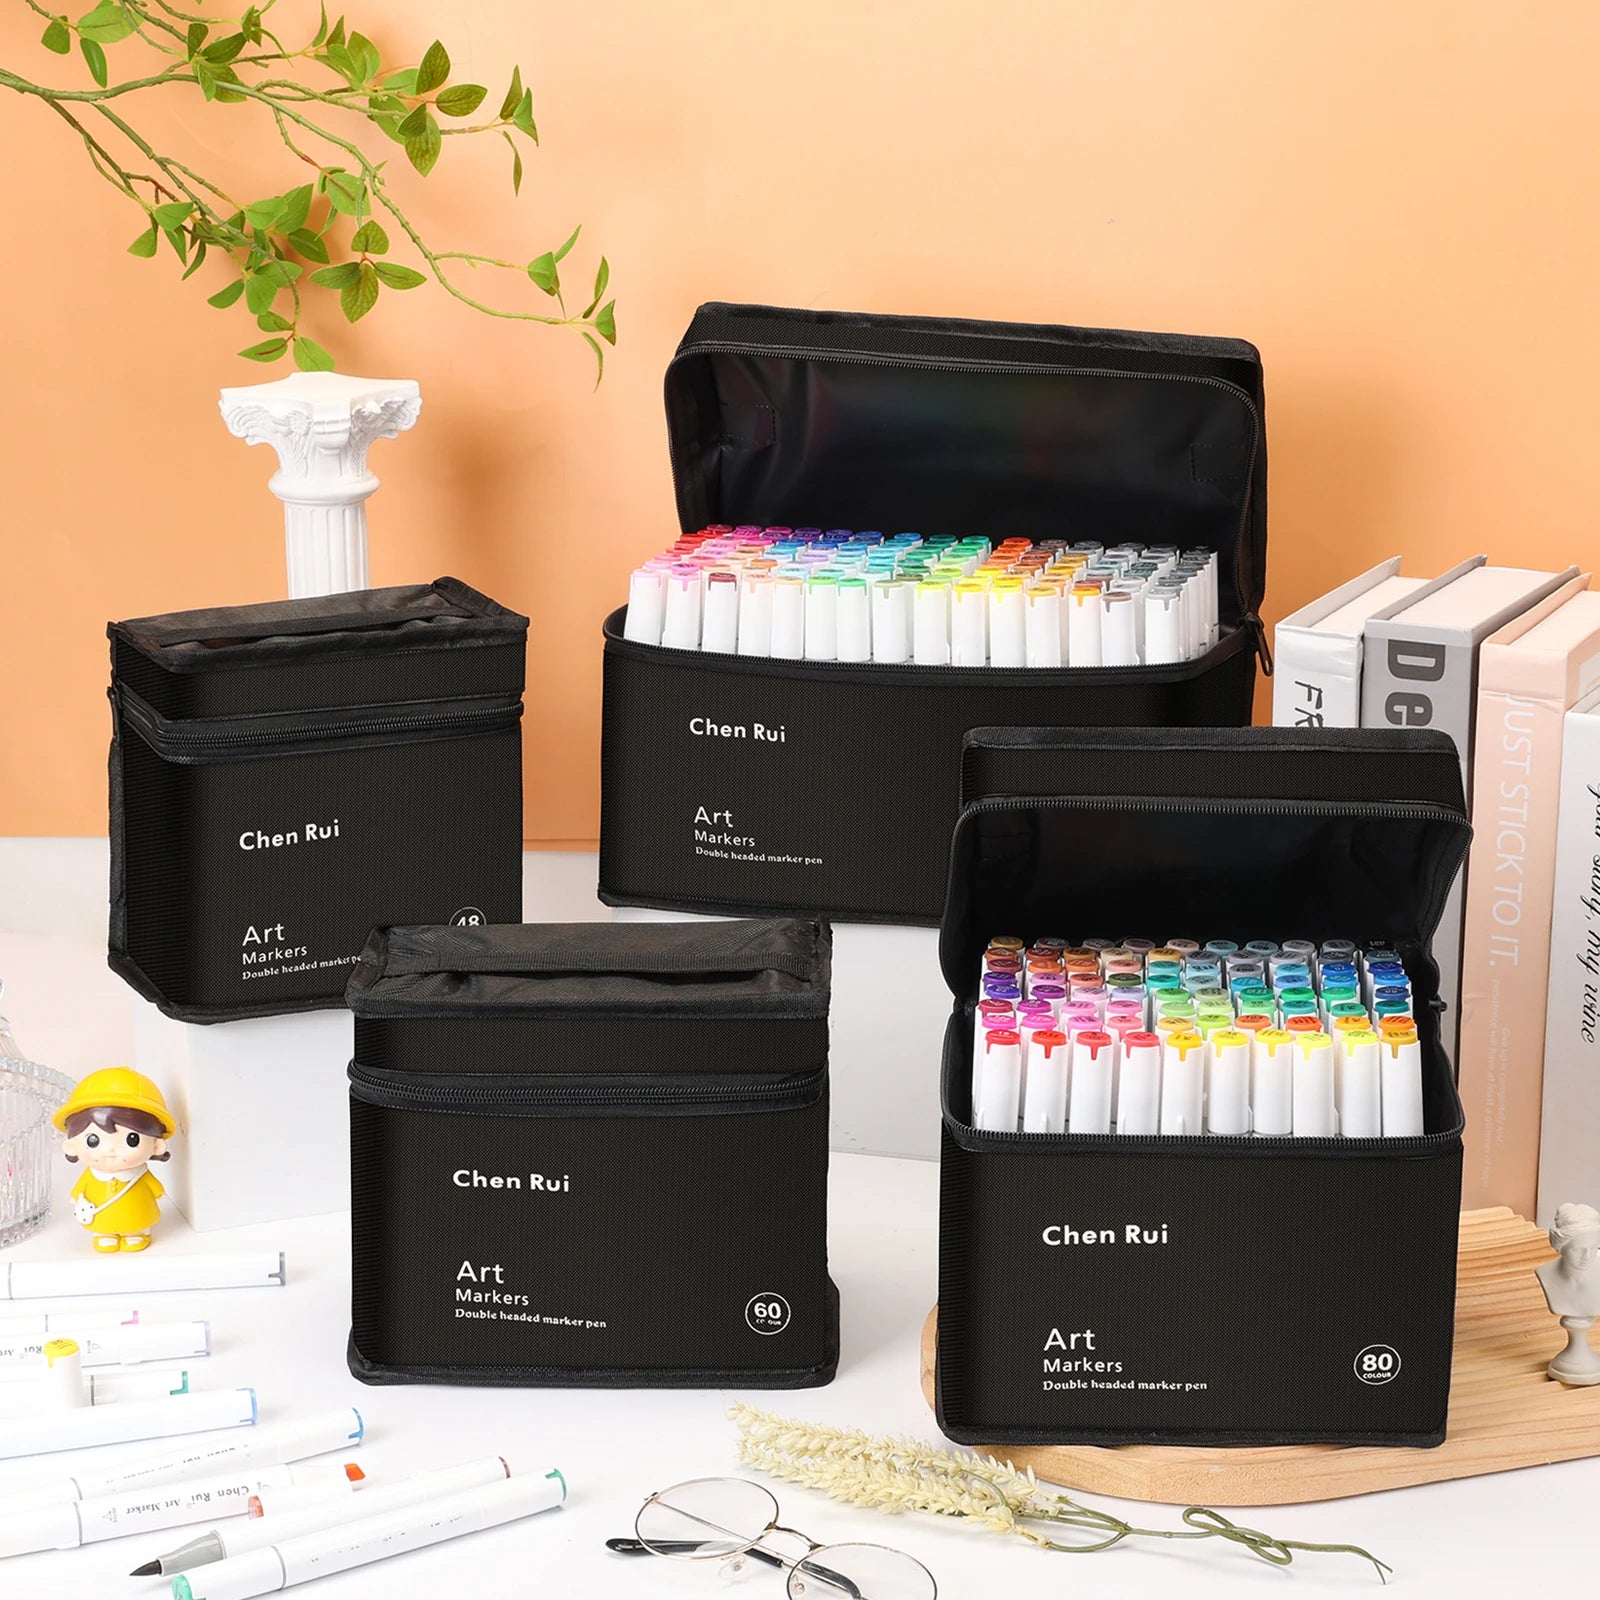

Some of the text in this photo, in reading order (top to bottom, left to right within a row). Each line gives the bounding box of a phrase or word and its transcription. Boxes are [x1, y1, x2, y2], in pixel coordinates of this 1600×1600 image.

[1385, 639, 1446, 726] De
[689, 718, 786, 742] Chen Rui
[693, 805, 734, 828] Art
[239, 818, 340, 851] Chen Rui
[694, 829, 756, 847] Markers
[1488, 697, 1535, 967] JUST STICK TO IT.
[695, 846, 823, 866] Double headed marker pen
[242, 922, 285, 947] Art
[242, 945, 308, 966] Markers
[242, 966, 280, 981] Double
[281, 959, 318, 975] headed
[1580, 983, 1600, 1043] wine
[452, 1169, 570, 1193] Chen Rui
[1042, 1223, 1168, 1246] Chen Rui
[456, 1260, 505, 1284] Art
[455, 1288, 530, 1307] Markers
[454, 1308, 607, 1329] Double headed marker pen
[754, 1302, 782, 1319] 60
[1043, 1327, 1096, 1352] Art
[1043, 1357, 1123, 1373] Markers
[1362, 1353, 1393, 1372] 80
[1042, 1379, 1208, 1392] Double headed marker pen
[1362, 1371, 1392, 1379] COLOUR
[217, 1485, 250, 1498] Chen
[126, 1502, 161, 1515] Marker
[164, 1498, 181, 1508] Art
